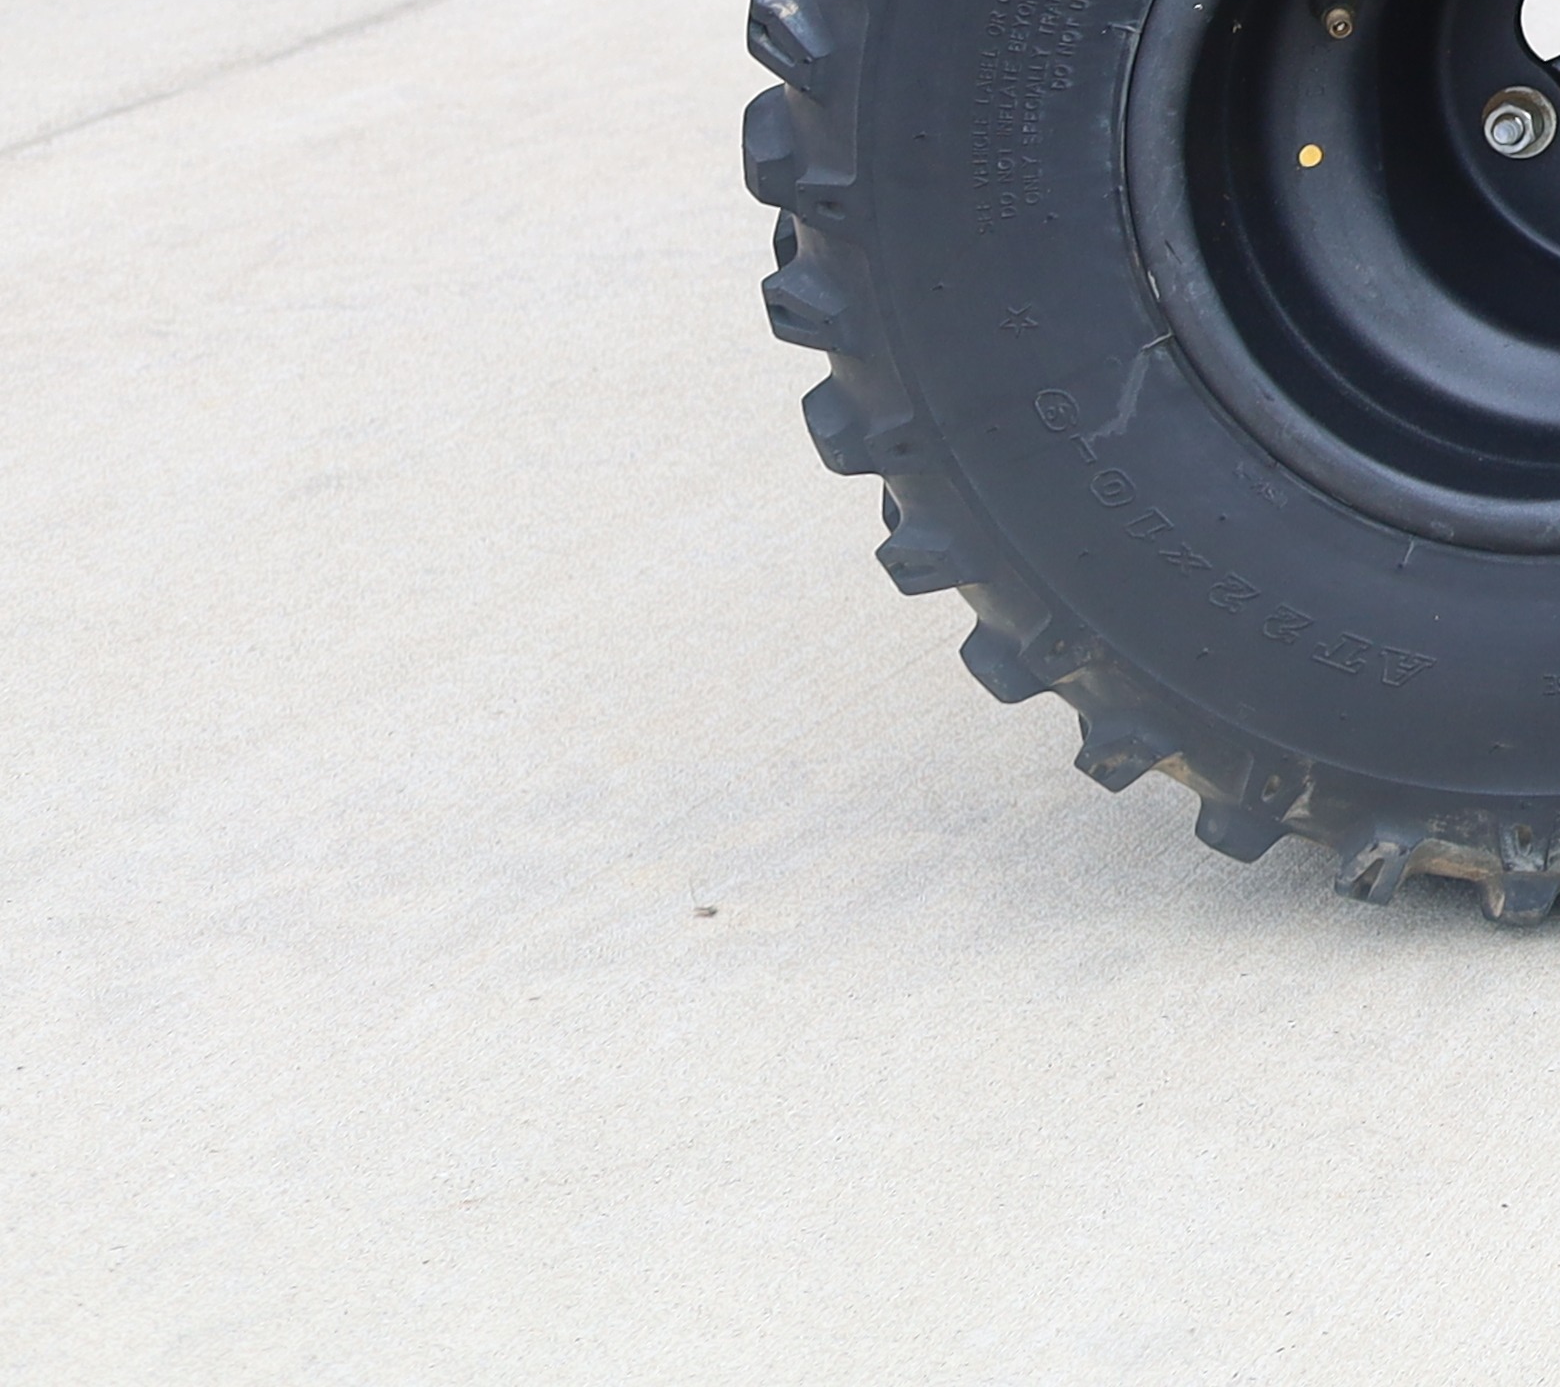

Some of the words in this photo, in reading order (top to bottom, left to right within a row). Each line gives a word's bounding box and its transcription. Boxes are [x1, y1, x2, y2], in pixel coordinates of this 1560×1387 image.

[983, 7, 1010, 37] OR
[973, 45, 1000, 104] LABEL
[996, 148, 1015, 181] NOT
[1021, 154, 1042, 205] ONLY
